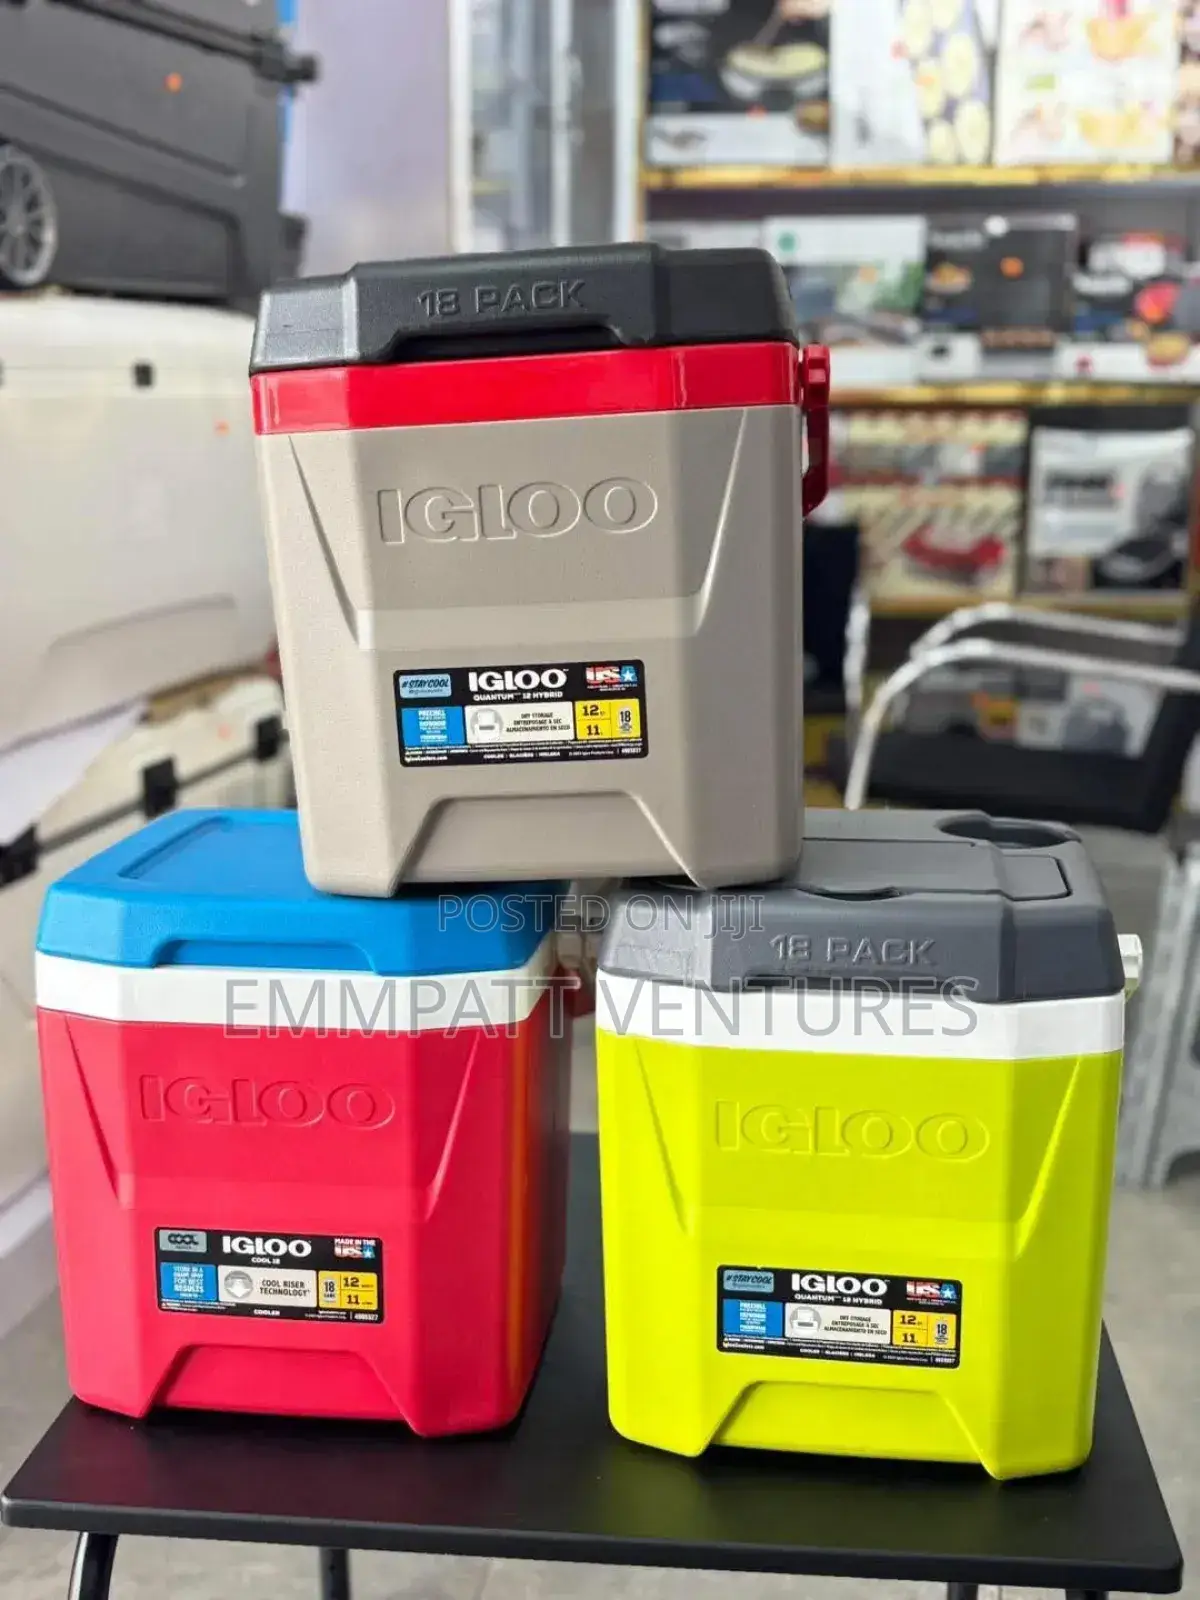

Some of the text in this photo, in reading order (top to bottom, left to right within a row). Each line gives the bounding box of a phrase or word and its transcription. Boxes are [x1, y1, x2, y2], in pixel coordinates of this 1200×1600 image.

[417, 279, 585, 316] 18 PACK
[377, 476, 658, 545] IGLOO
[468, 668, 567, 692] IGLOO
[473, 693, 514, 701] QUANTUM
[532, 691, 563, 699] HYBRID
[583, 704, 599, 716] 12
[620, 710, 631, 722] 18
[586, 724, 600, 735] 11
[769, 934, 936, 966] 18 PACK
[139, 1074, 396, 1131] IGLOO
[715, 1098, 990, 1164] IGLOO
[168, 1233, 199, 1246] COOL
[222, 1235, 312, 1258] IGLOO
[261, 1279, 305, 1289] COOL RISER
[324, 1281, 335, 1292] 18
[343, 1277, 360, 1288] 12
[791, 1273, 888, 1296] IGLOO
[259, 1287, 308, 1297] TECHNOLOGY
[346, 1294, 360, 1305] 11
[794, 1293, 834, 1302] QUANTUM
[853, 1297, 883, 1305] HYBRID
[900, 1315, 916, 1325] 12
[937, 1324, 948, 1335] 18
[903, 1333, 915, 1343] 11
